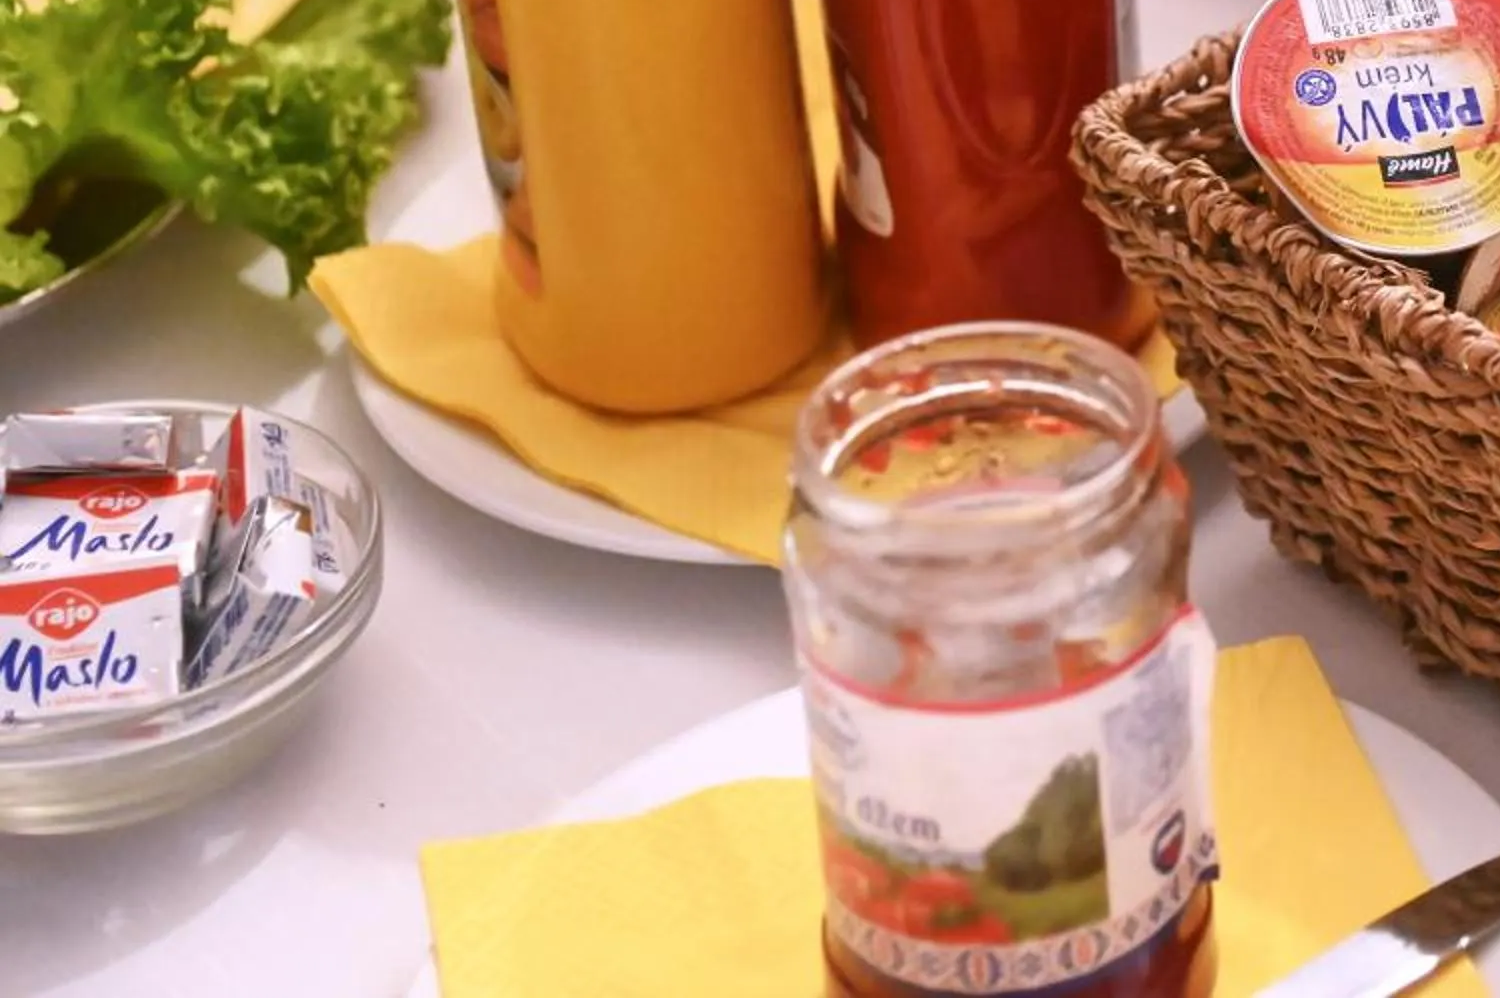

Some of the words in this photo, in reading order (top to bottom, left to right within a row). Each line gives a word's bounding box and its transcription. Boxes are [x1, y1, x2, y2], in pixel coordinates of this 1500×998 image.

[1324, 47, 1347, 66] 48
[1354, 63, 1434, 90] krém
[85, 492, 143, 512] rajo
[8, 514, 174, 561] Maslo
[34, 597, 95, 630] rajo
[0, 629, 138, 708] Maslo
